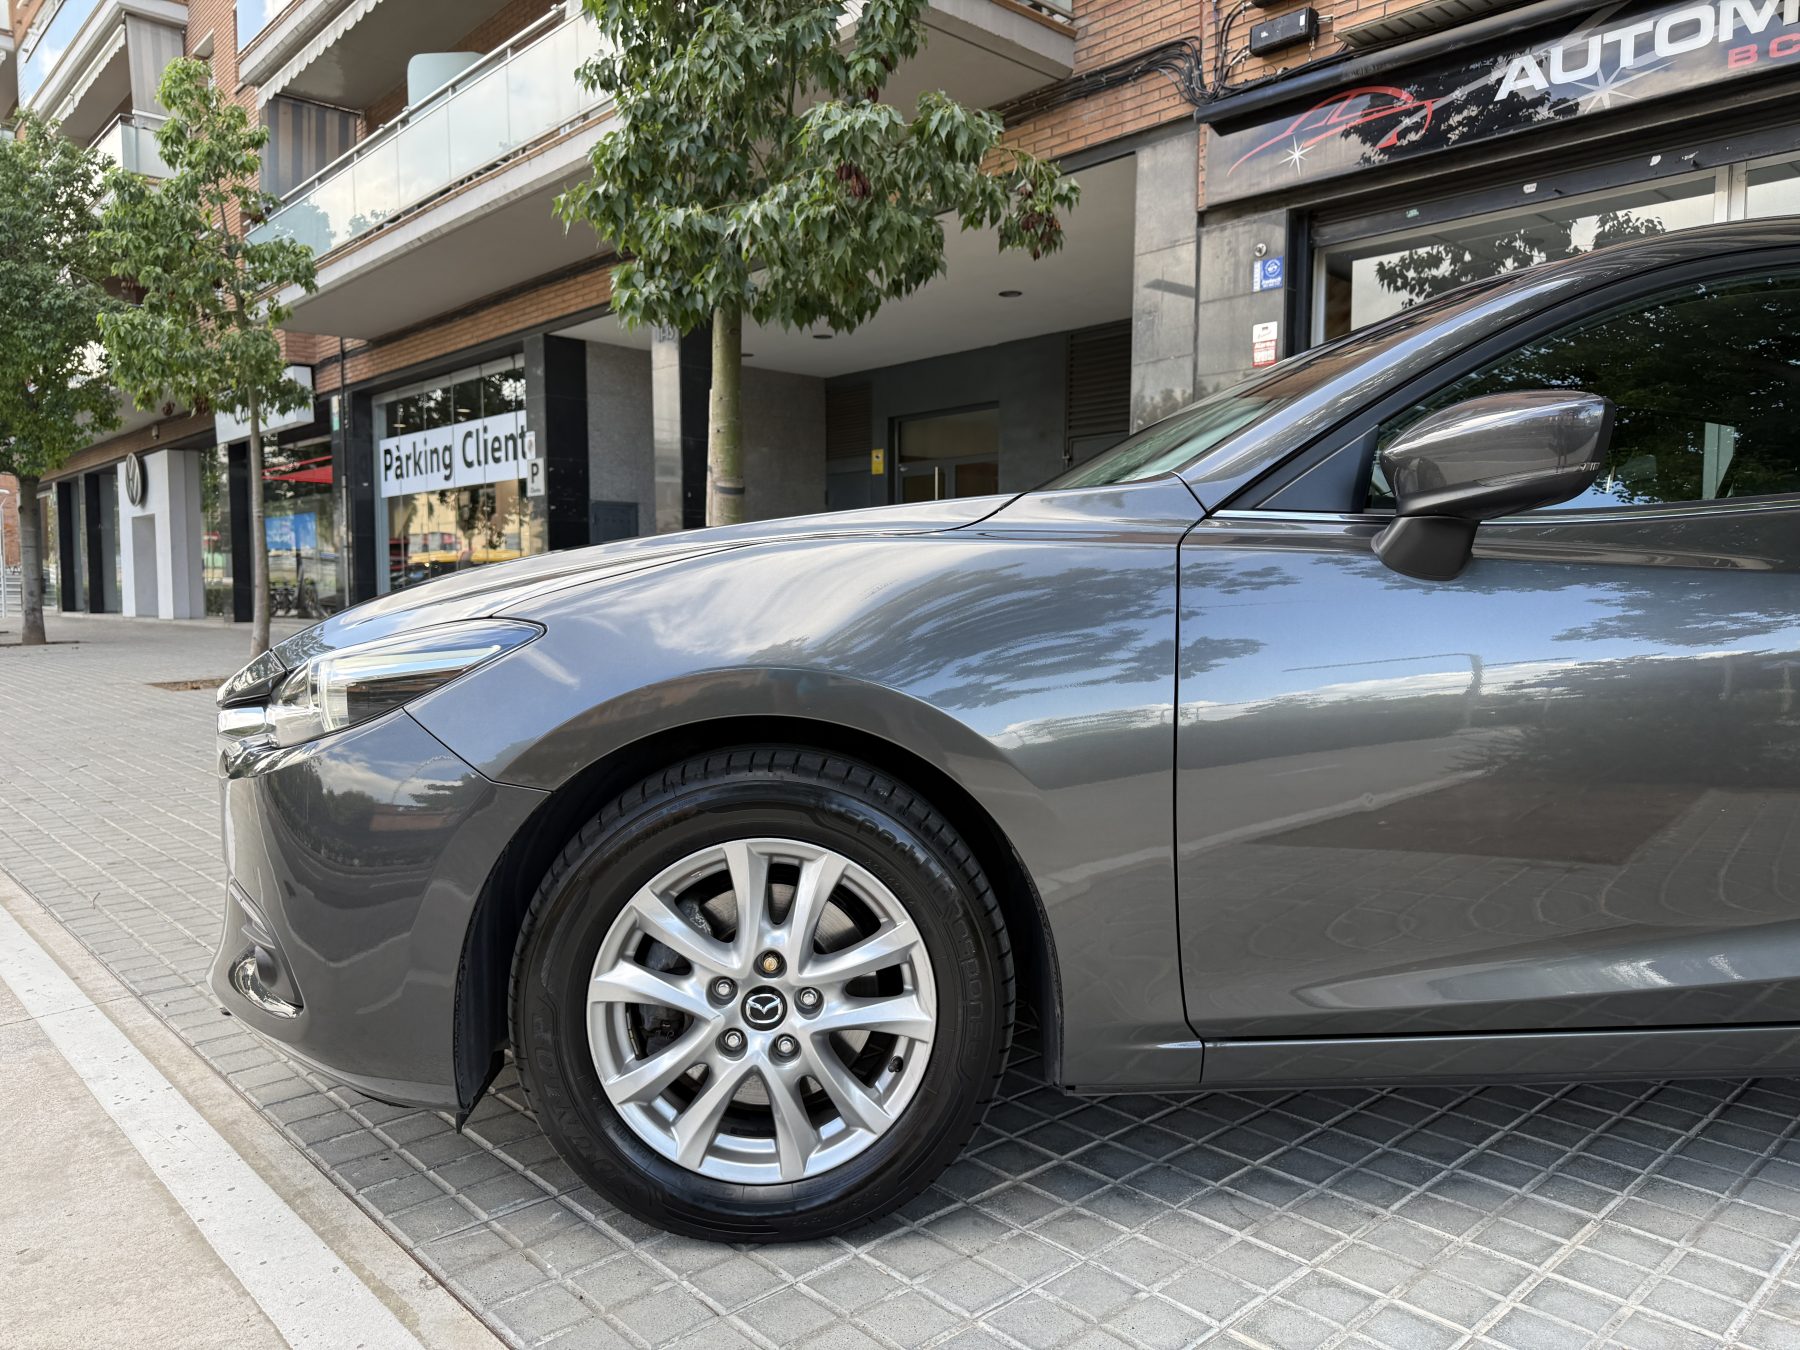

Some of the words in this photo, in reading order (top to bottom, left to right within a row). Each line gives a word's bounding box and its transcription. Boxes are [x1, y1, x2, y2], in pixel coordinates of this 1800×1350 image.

[1494, 0, 1800, 101] AUTOM
[384, 437, 453, 481] Pàrking
[531, 462, 540, 484] P
